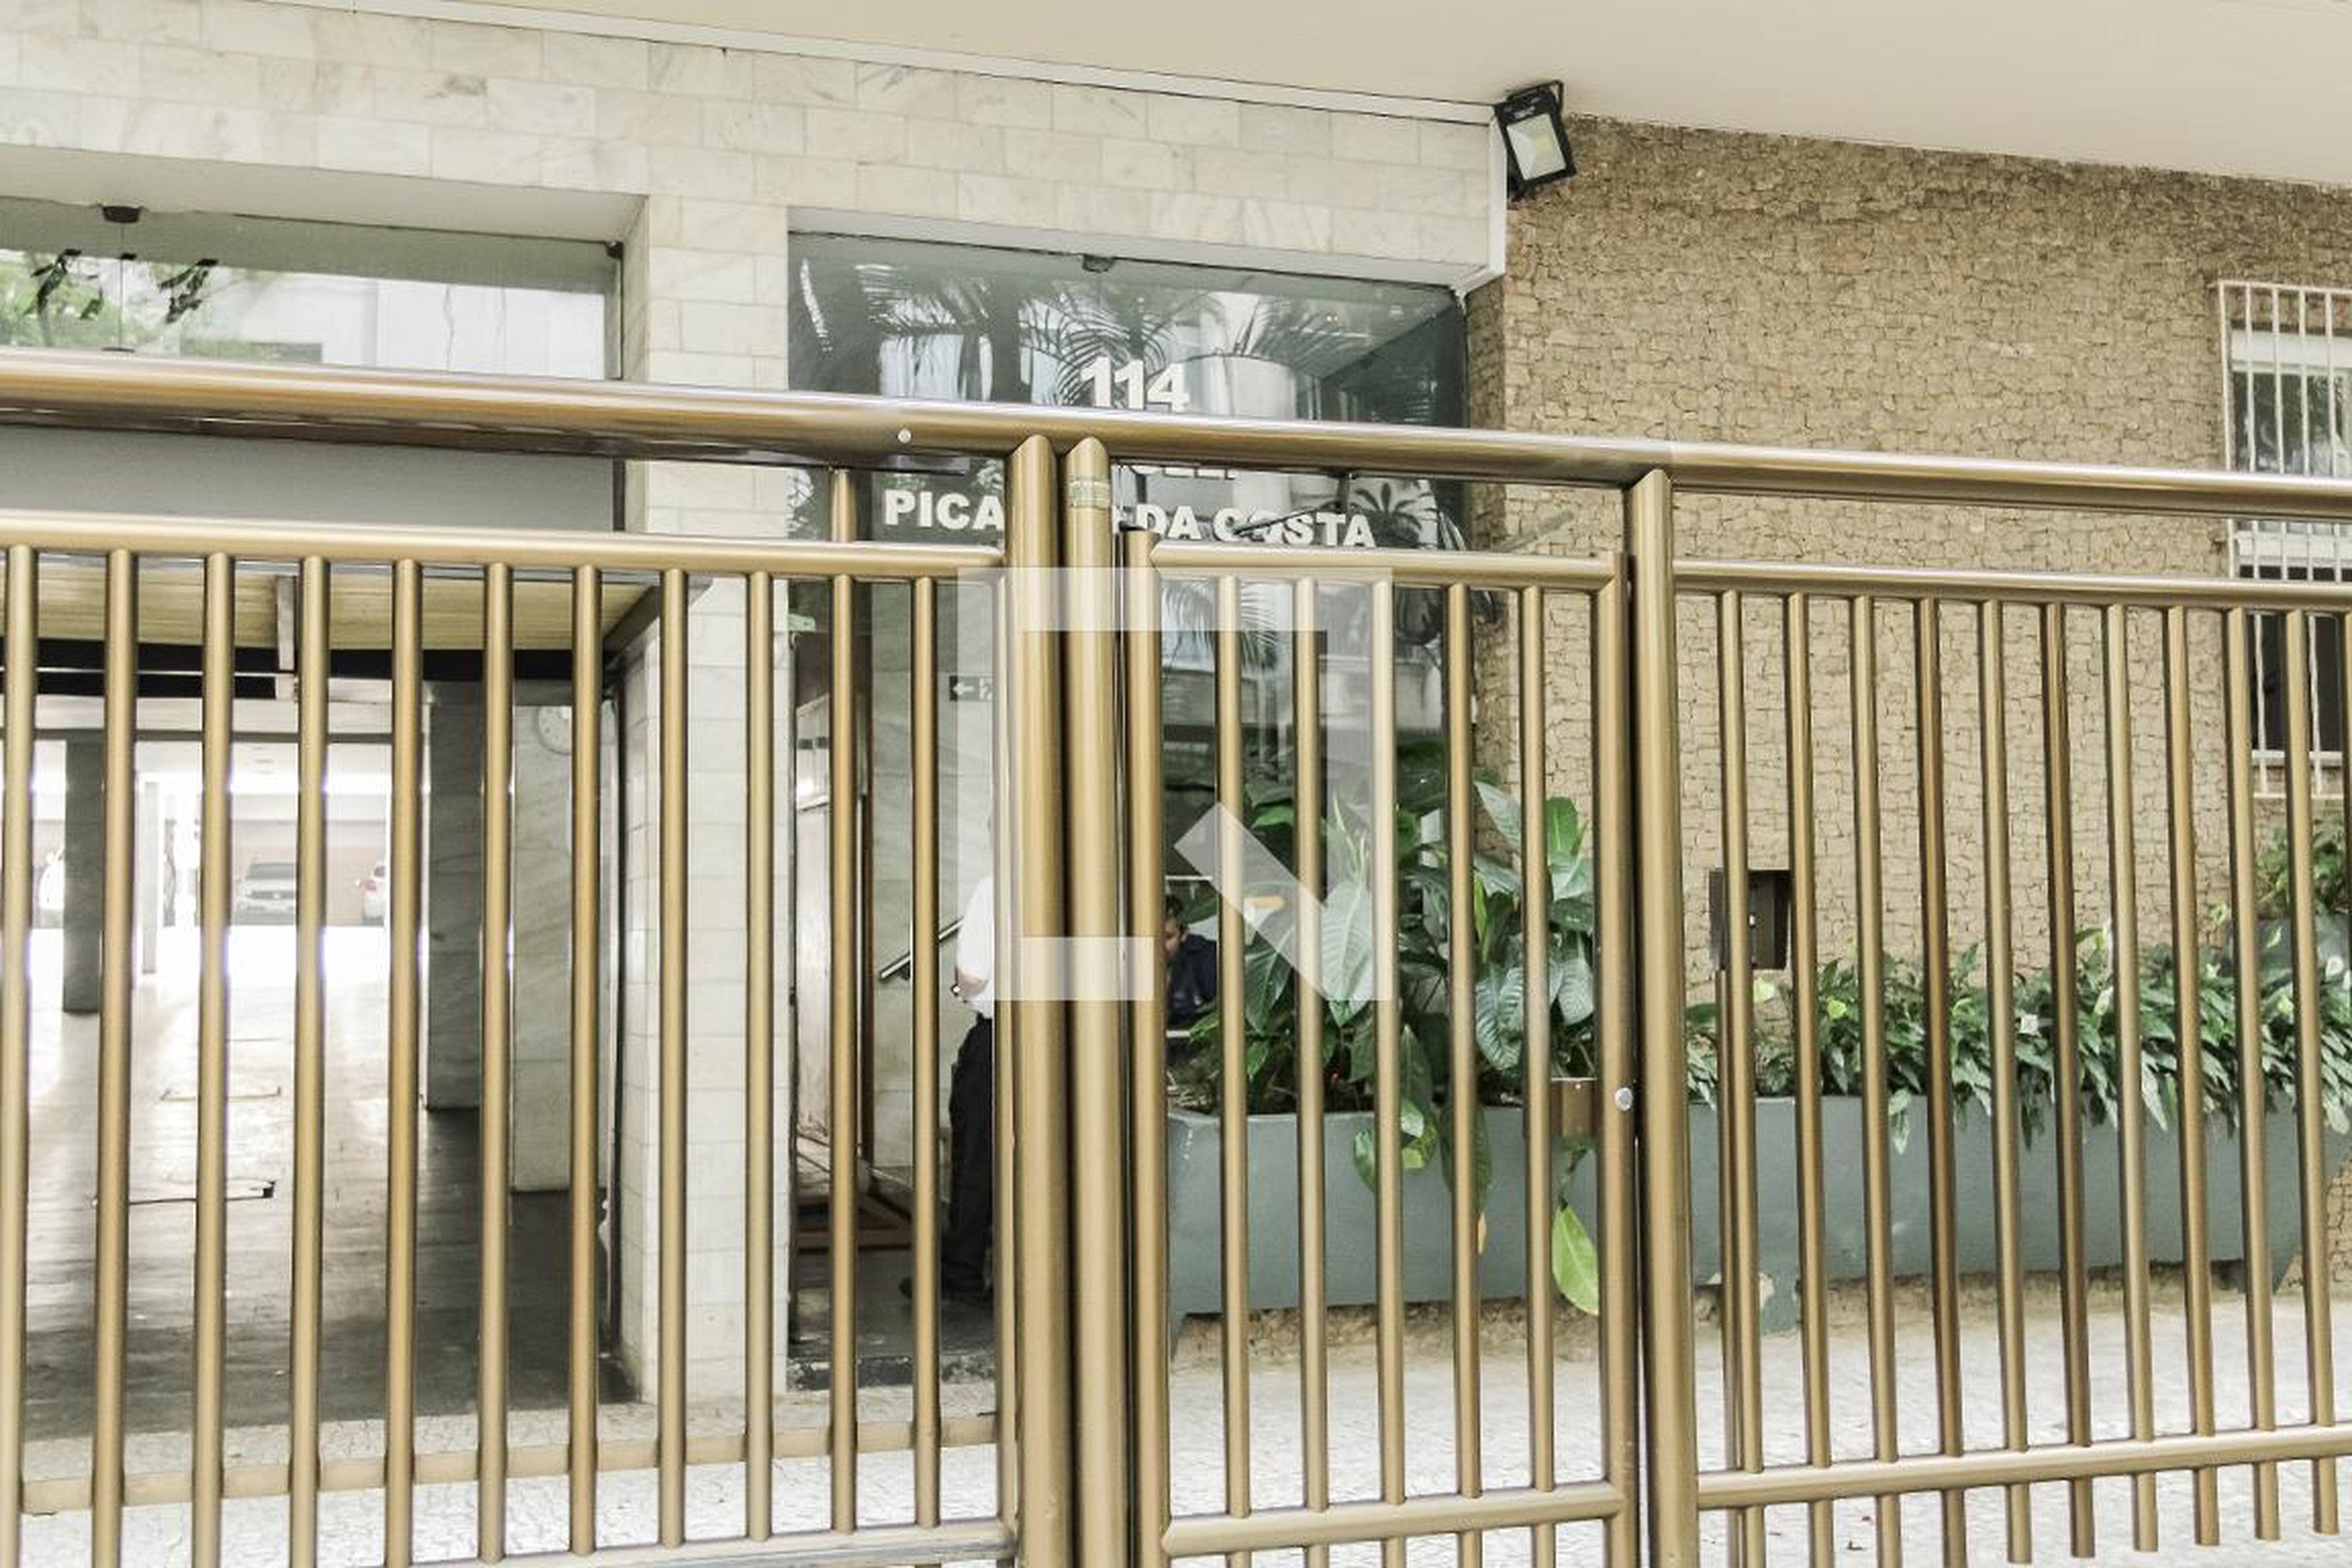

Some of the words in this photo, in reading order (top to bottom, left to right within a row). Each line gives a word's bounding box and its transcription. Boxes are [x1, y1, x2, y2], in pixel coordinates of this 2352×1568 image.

[1080, 356, 1190, 412] 114
[885, 489, 1006, 530] PICA
[1136, 503, 1202, 540] DA
